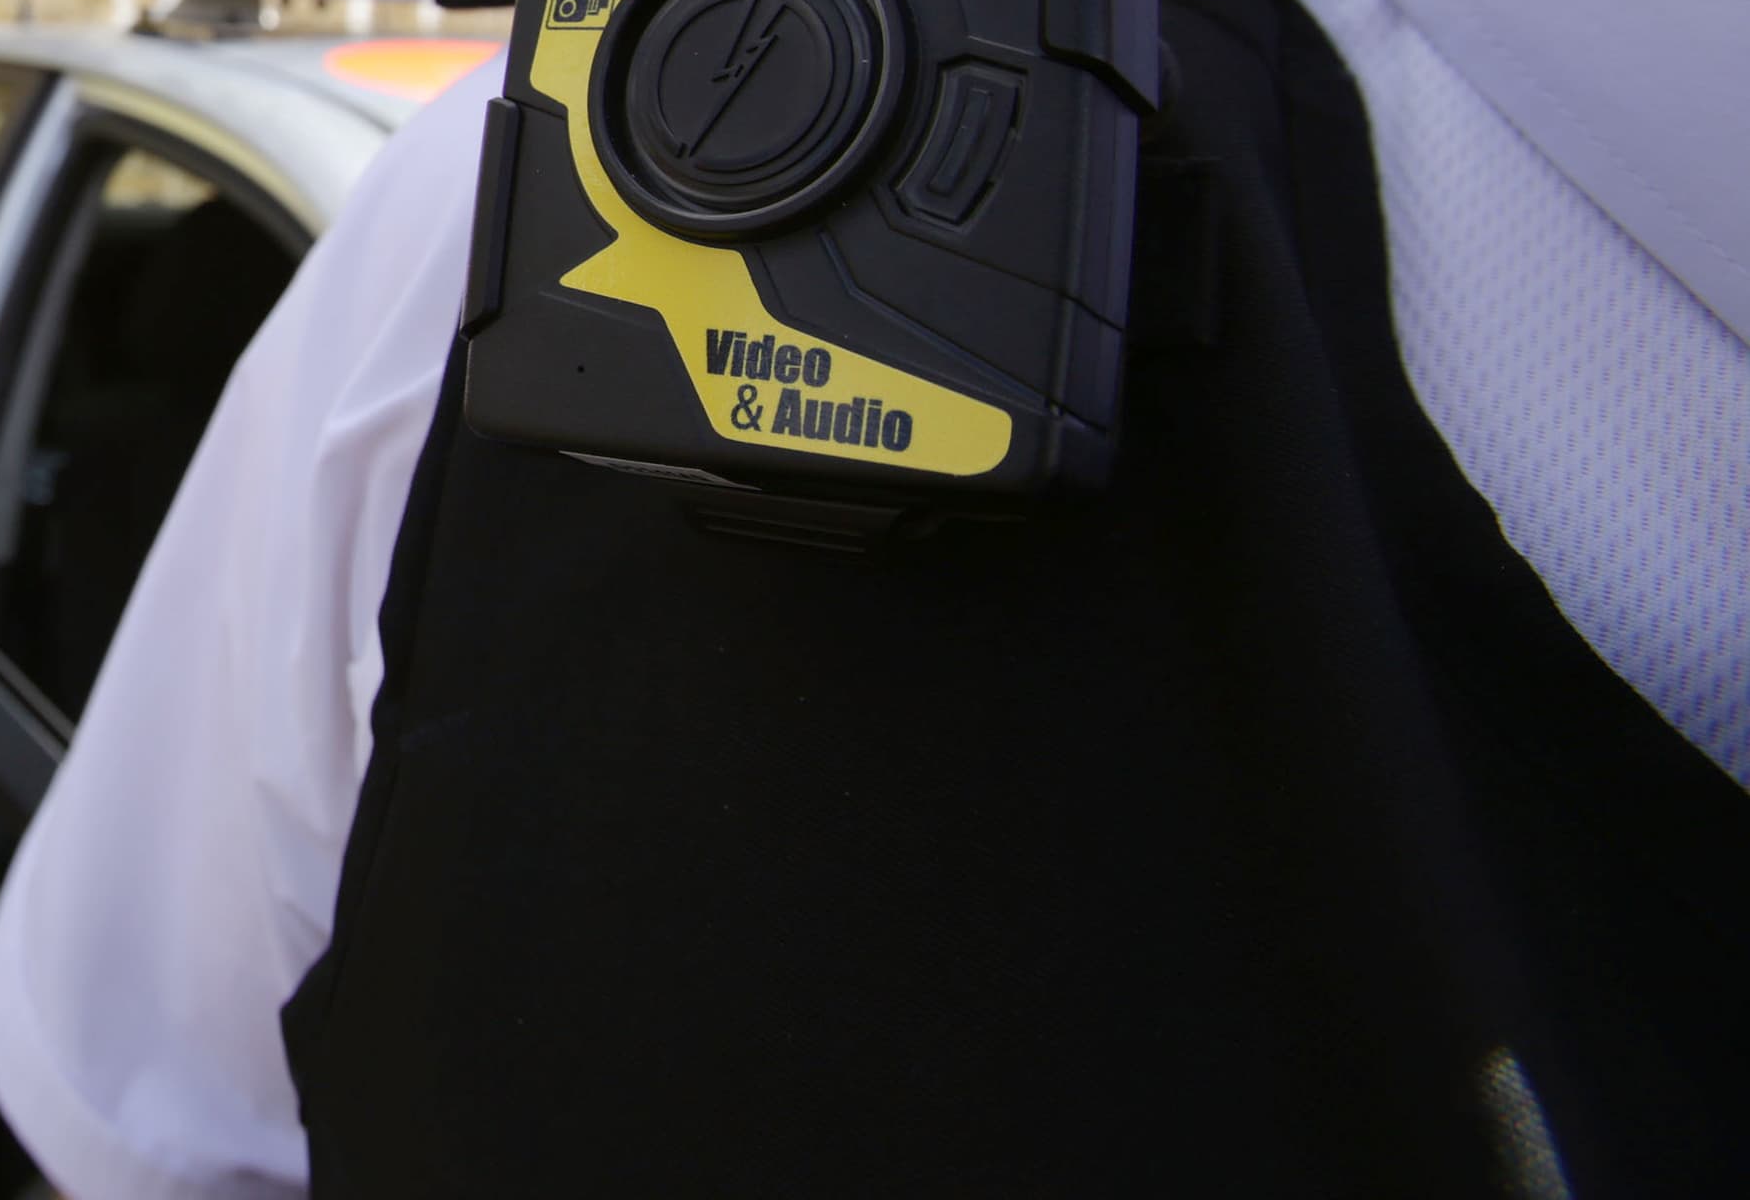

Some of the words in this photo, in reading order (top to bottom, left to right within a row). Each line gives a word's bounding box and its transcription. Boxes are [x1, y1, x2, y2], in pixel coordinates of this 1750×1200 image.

[706, 328, 832, 388] Video
[730, 384, 763, 432] &
[771, 387, 913, 453] Audio
